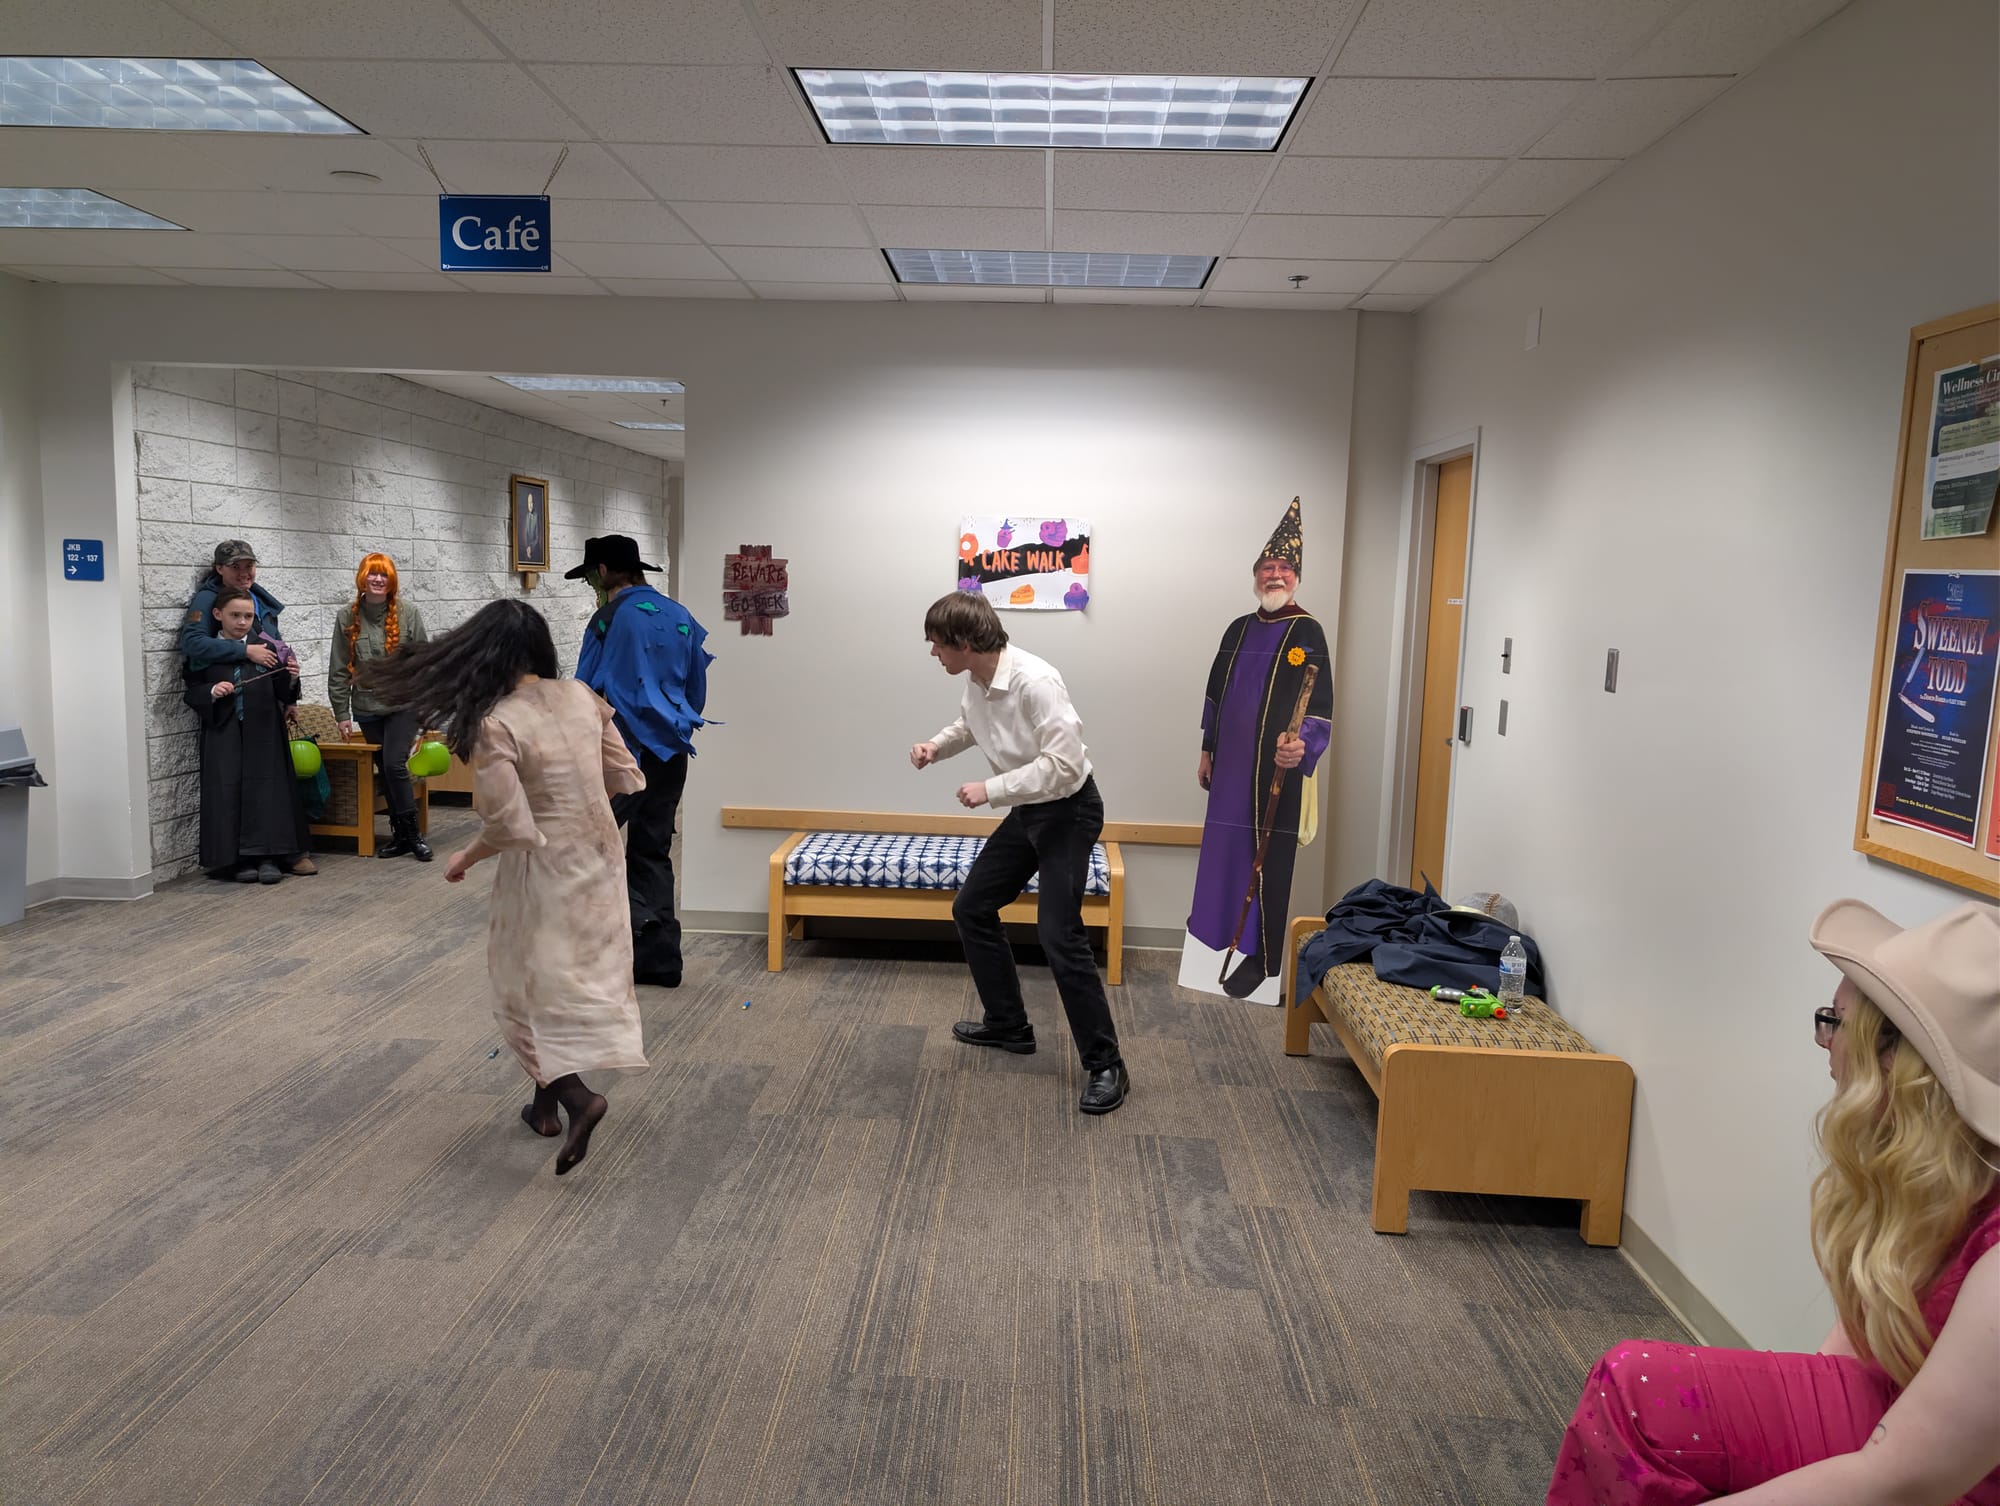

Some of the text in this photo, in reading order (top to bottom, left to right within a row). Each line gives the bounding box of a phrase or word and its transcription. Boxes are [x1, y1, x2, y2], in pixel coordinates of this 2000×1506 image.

[452, 215, 540, 251] Café
[1943, 376, 1984, 396] Wellness
[67, 543, 81, 551] JKB
[67, 553, 79, 561] 122
[86, 554, 98, 562] 137
[981, 549, 1066, 573] CAKE WALK
[731, 562, 785, 584] BEWARE
[731, 597, 749, 612] GO
[1914, 601, 1989, 655] SWEENEY
[1927, 656, 1967, 694] TODD
